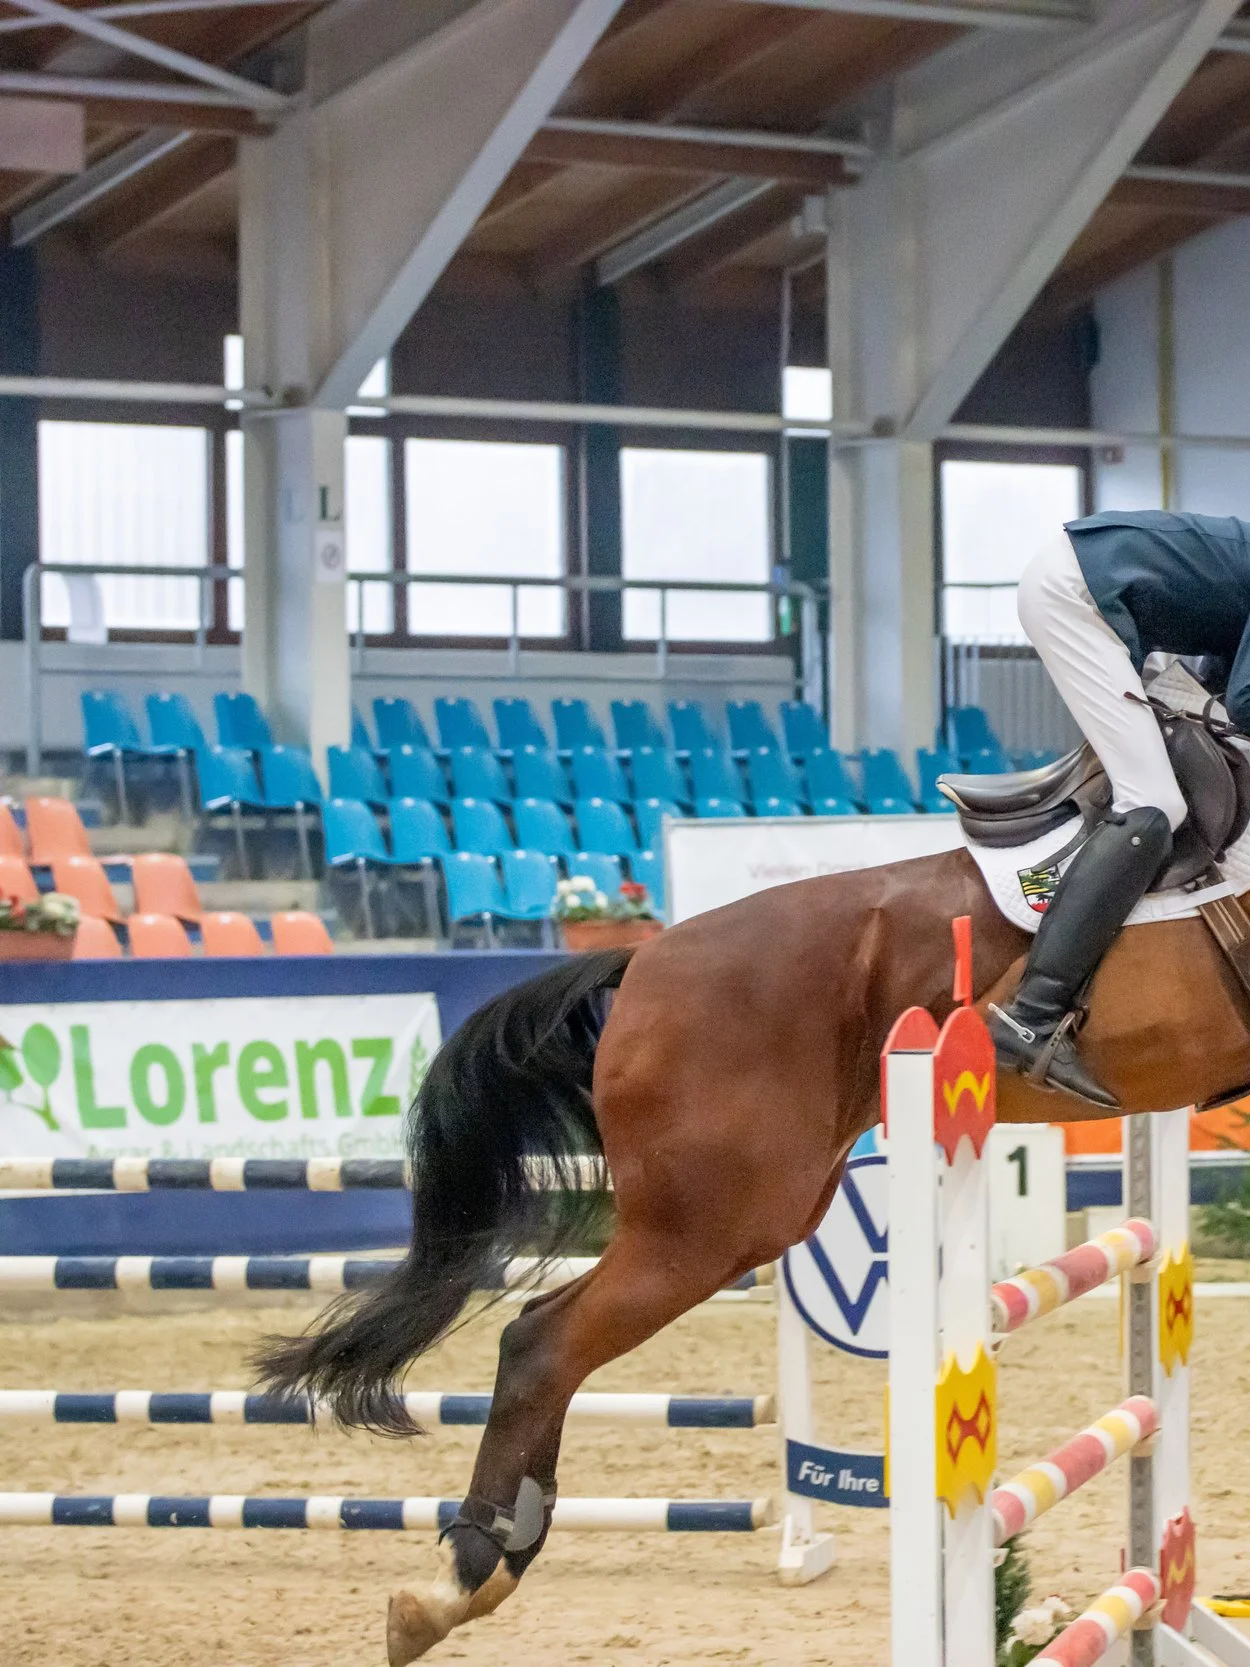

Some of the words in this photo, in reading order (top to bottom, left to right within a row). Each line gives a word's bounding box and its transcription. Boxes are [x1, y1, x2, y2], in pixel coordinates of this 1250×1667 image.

[69, 1024, 401, 1130] Lorenz
[1006, 1144, 1029, 1197] 1
[797, 1460, 835, 1487] Für
[838, 1468, 880, 1493] Ihre
